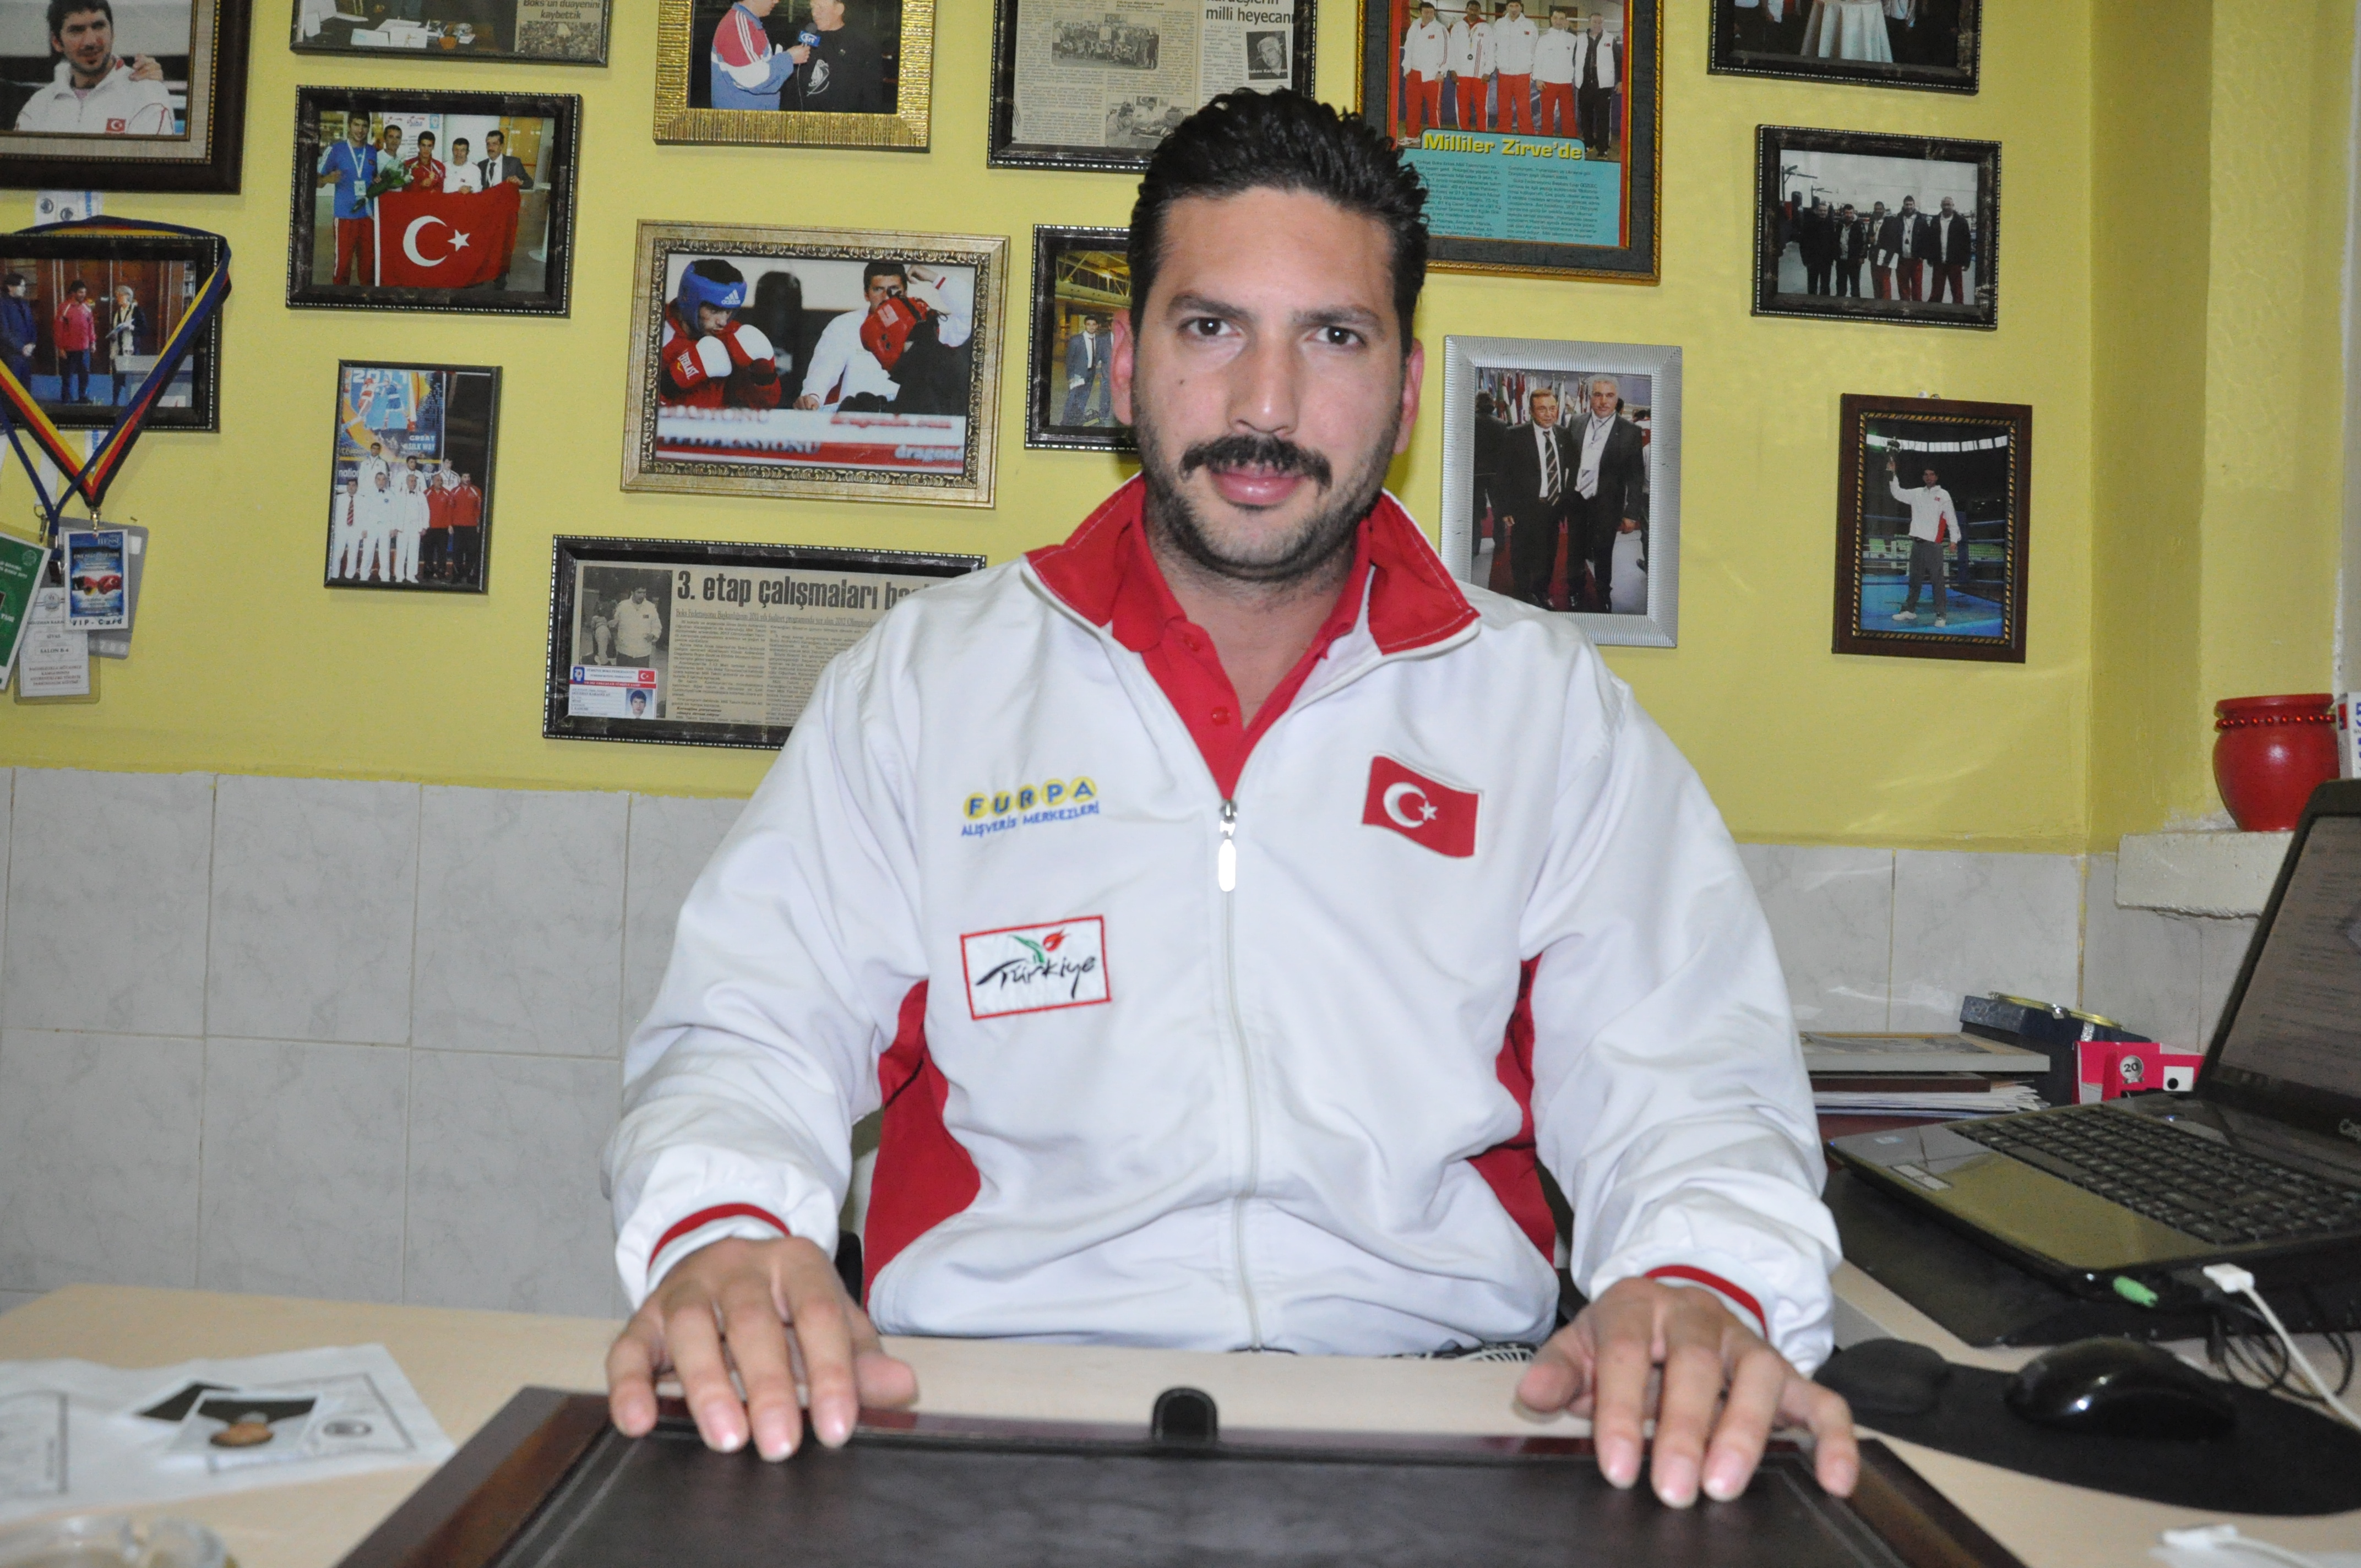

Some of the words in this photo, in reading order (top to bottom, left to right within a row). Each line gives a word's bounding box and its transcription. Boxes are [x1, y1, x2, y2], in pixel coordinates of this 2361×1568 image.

[540, 9, 581, 20] kaybettik
[1206, 6, 1233, 20] milli
[1423, 133, 1495, 154] Milliler
[1502, 138, 1583, 160] Zirve'de
[353, 368, 408, 384] 2011
[677, 570, 695, 600] 3.
[703, 573, 752, 607] etap
[758, 576, 878, 610] çalışmaları
[967, 780, 1095, 816] FURPA
[975, 956, 1096, 1000] Türkiye
[2124, 1062, 2139, 1073] 20
